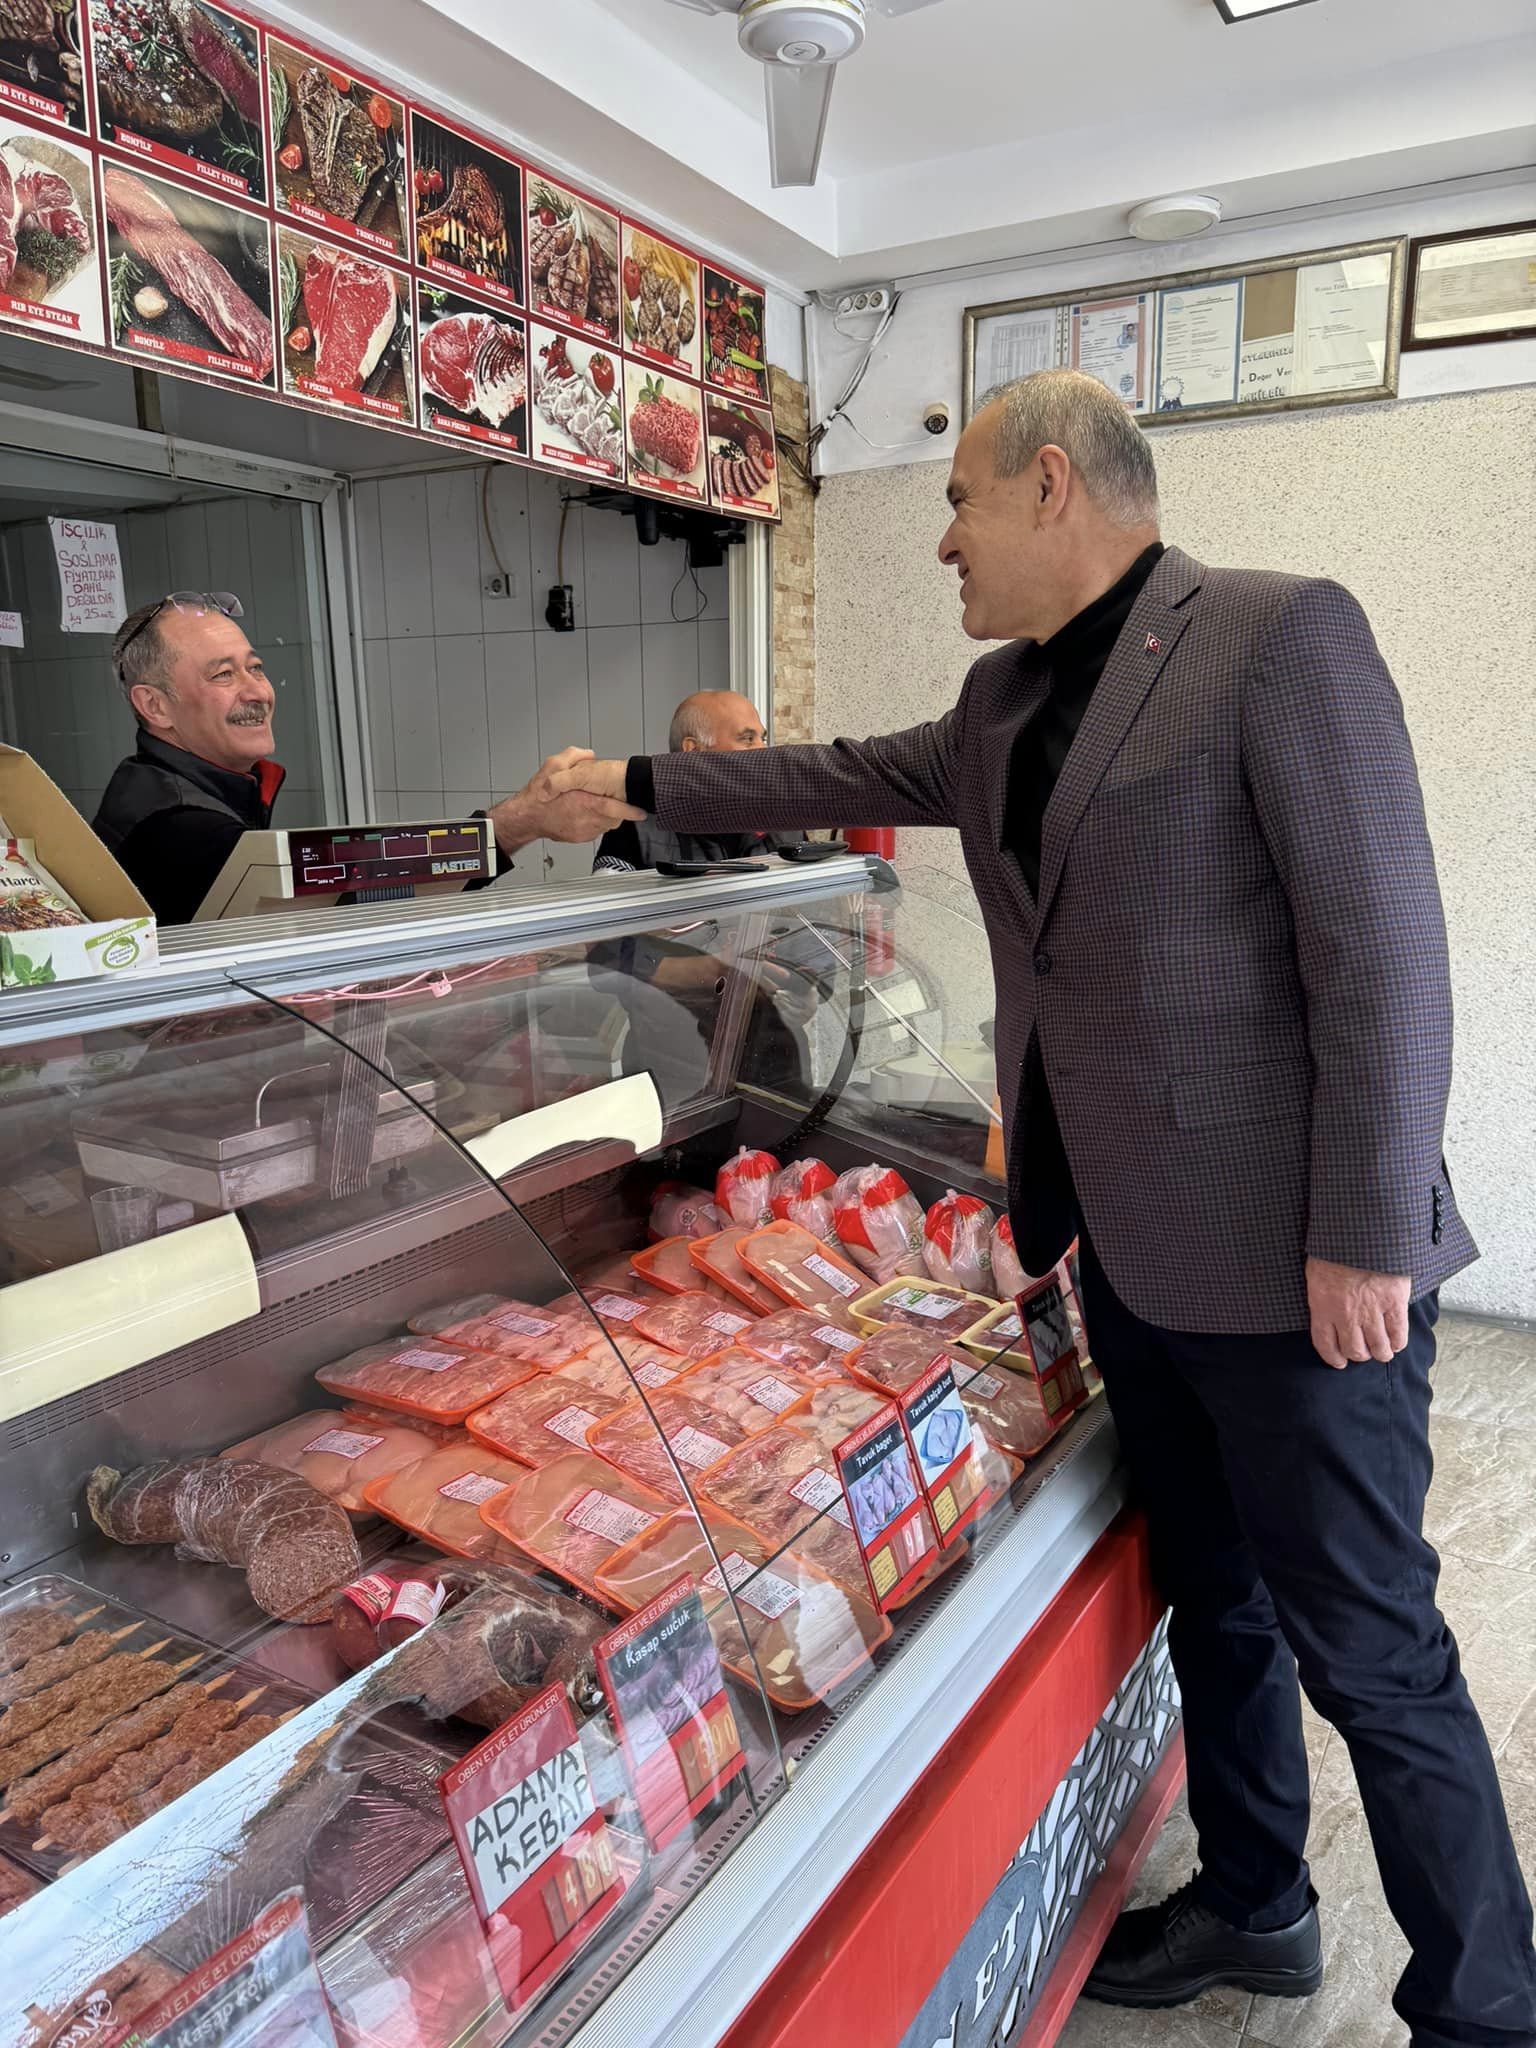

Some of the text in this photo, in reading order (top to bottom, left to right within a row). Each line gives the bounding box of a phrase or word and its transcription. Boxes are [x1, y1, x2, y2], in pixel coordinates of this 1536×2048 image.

[11, 88, 28, 103] EYE
[28, 95, 57, 115] STEAK
[221, 174, 244, 189] STEAK
[27, 304, 45, 316] EYE
[45, 309, 73, 324] STEAK
[231, 362, 254, 375] STEAK
[58, 550, 118, 568] SOSLAMA
[855, 1446, 877, 1468] Tavuk
[609, 1631, 630, 1652] OBEN
[628, 1622, 639, 1637] ET
[639, 1615, 649, 1628] VE
[647, 1607, 659, 1621] ET
[625, 1608, 691, 1669] Kasap sucuk
[457, 1758, 484, 1785] OBEN
[482, 1746, 495, 1763] ET
[494, 1736, 509, 1752] VE
[507, 1725, 520, 1741] ET
[471, 1750, 580, 1856] ADANA
[493, 1773, 589, 1885] KEBAP
[564, 1839, 613, 1908] 480
[174, 1990, 191, 2013] ET
[192, 1977, 211, 1996] VE
[213, 1962, 228, 1982] ET
